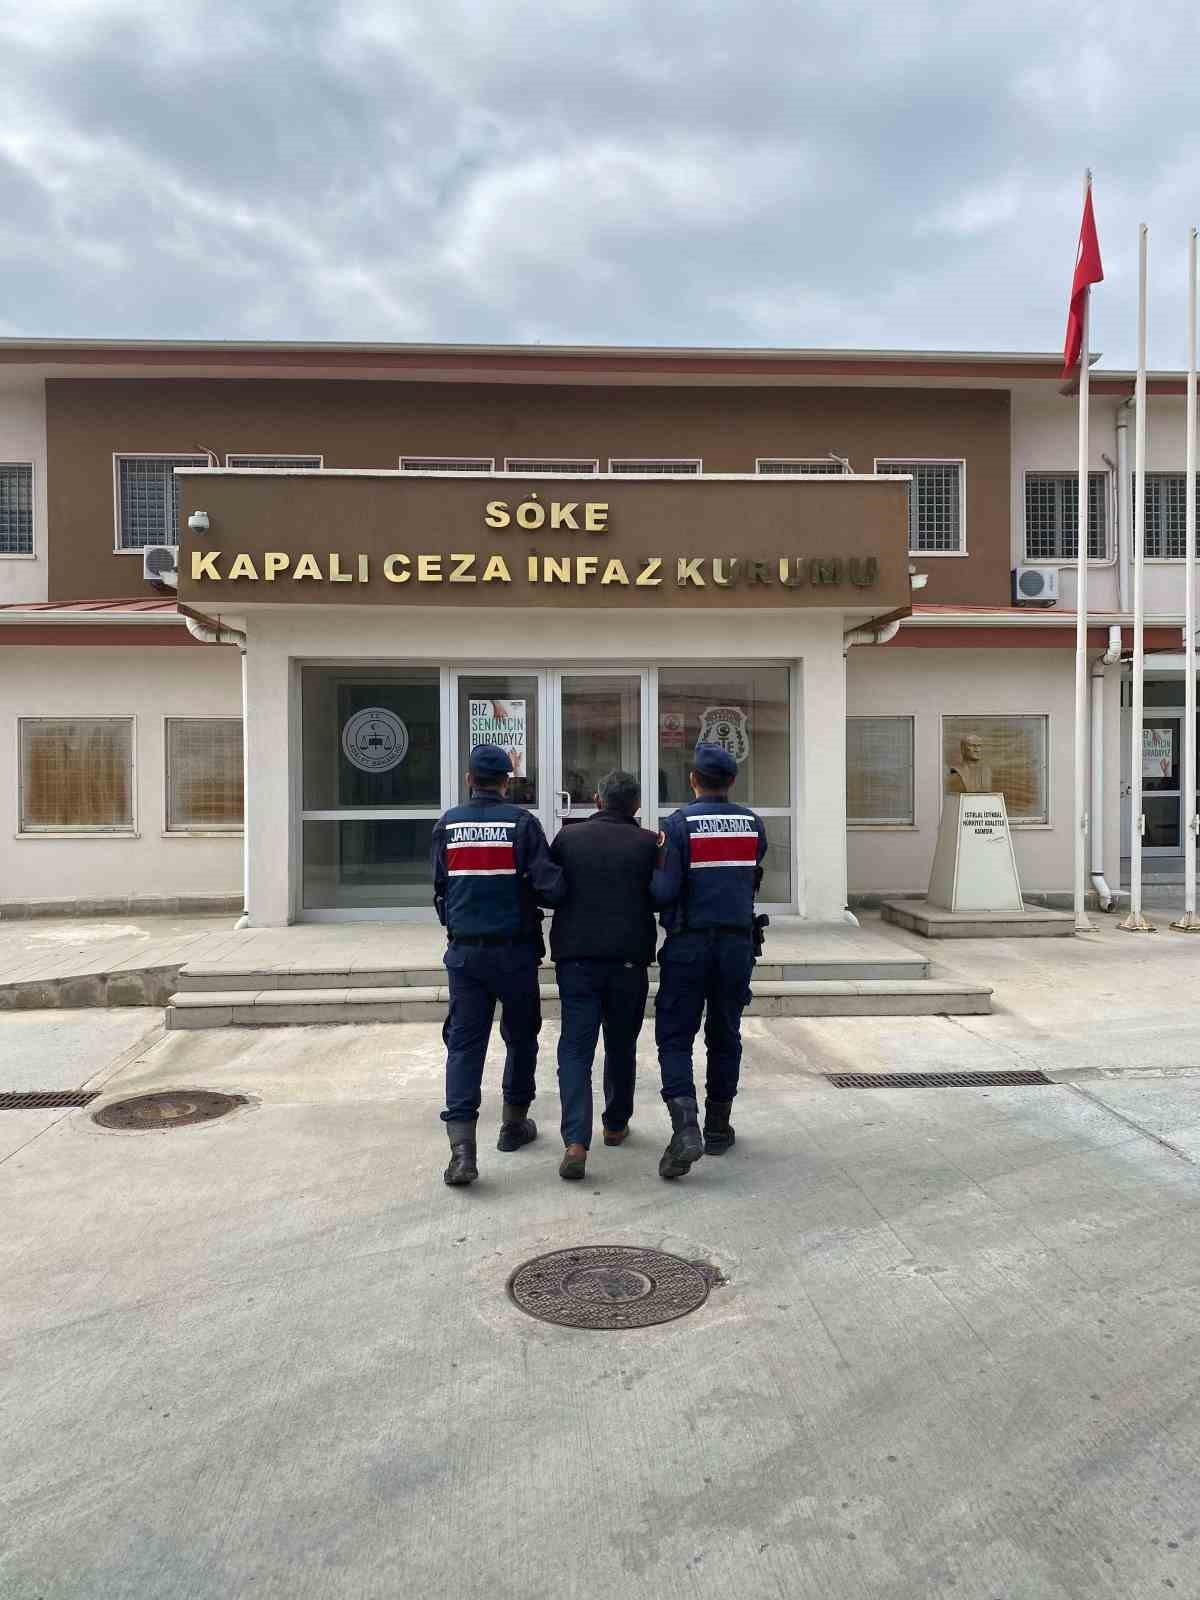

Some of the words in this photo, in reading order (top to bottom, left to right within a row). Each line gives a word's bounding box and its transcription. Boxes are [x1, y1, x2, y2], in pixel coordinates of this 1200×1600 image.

[191, 551, 369, 584] KAPALI
[383, 552, 512, 583] CEZA
[677, 557, 878, 588] KURUMU
[696, 818, 752, 834] JANDARMA
[451, 827, 508, 842] JANDARMA
